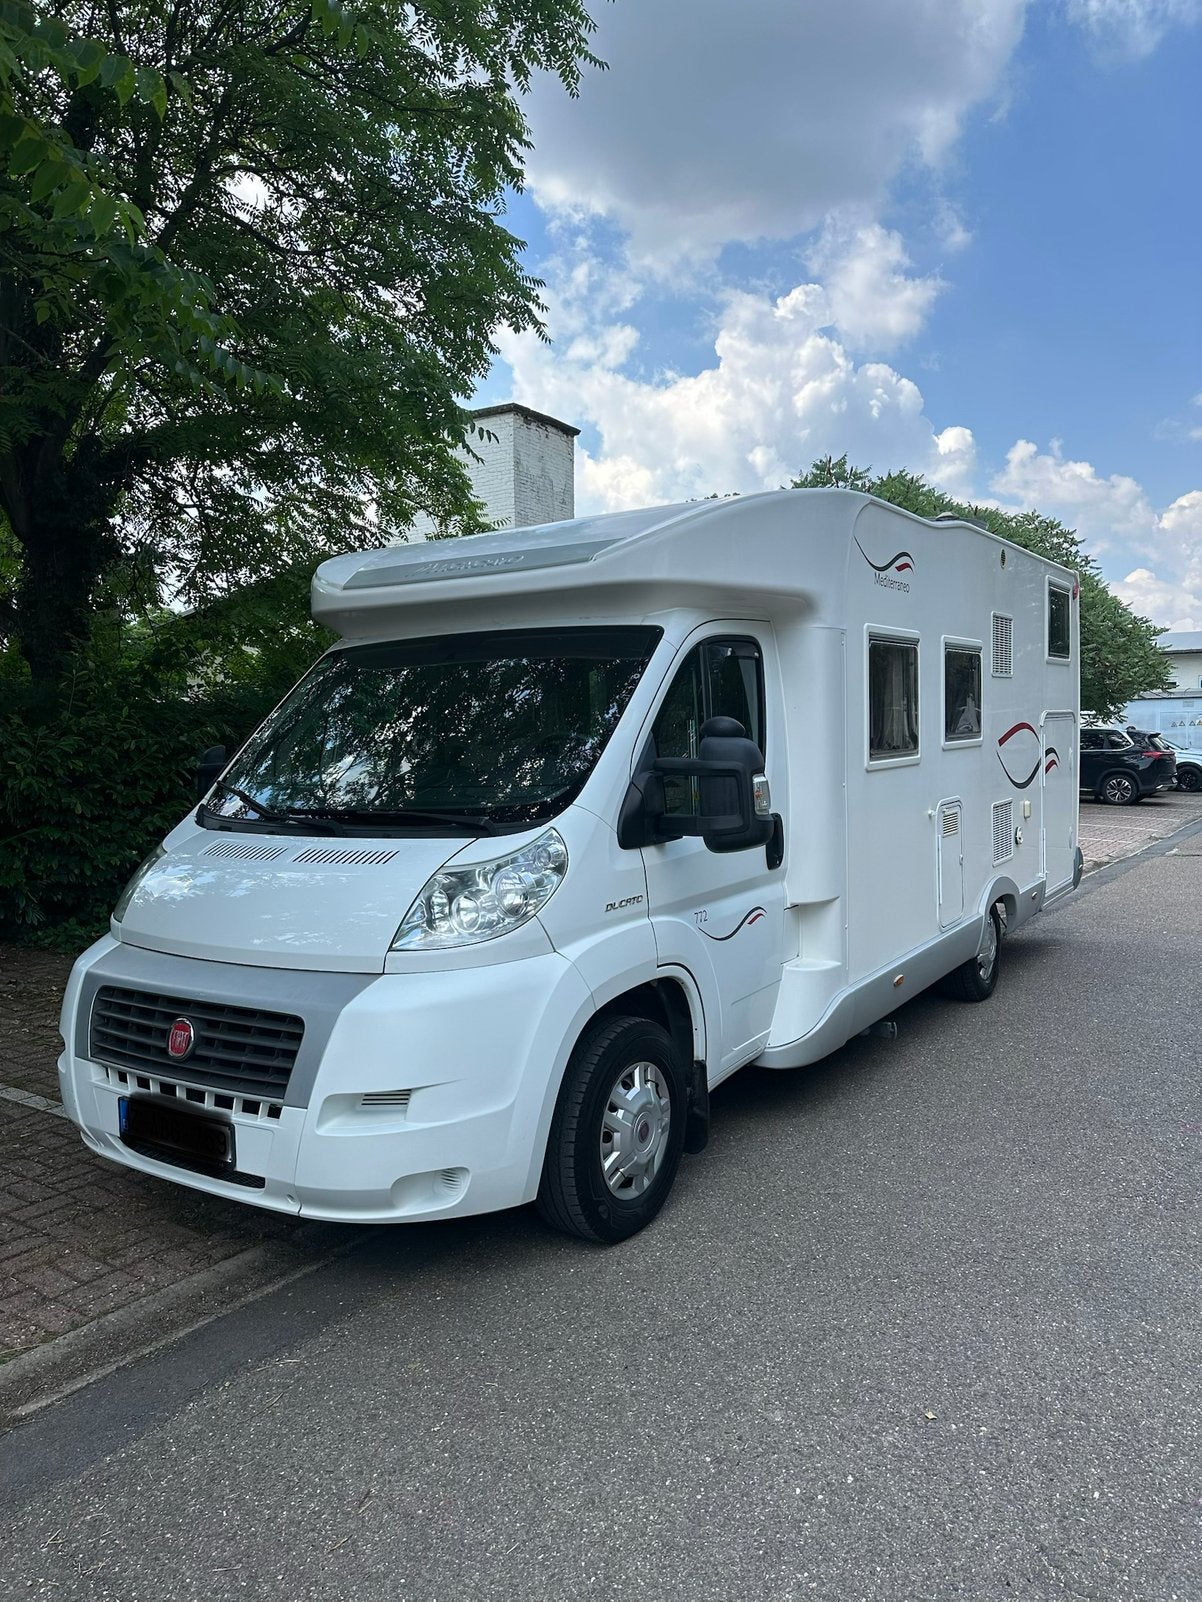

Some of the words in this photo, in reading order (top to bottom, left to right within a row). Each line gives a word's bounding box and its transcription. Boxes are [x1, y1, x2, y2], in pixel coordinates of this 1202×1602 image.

[874, 571, 911, 594] Mediterraneo
[605, 894, 643, 912] DUCATO
[694, 909, 708, 924] 772
